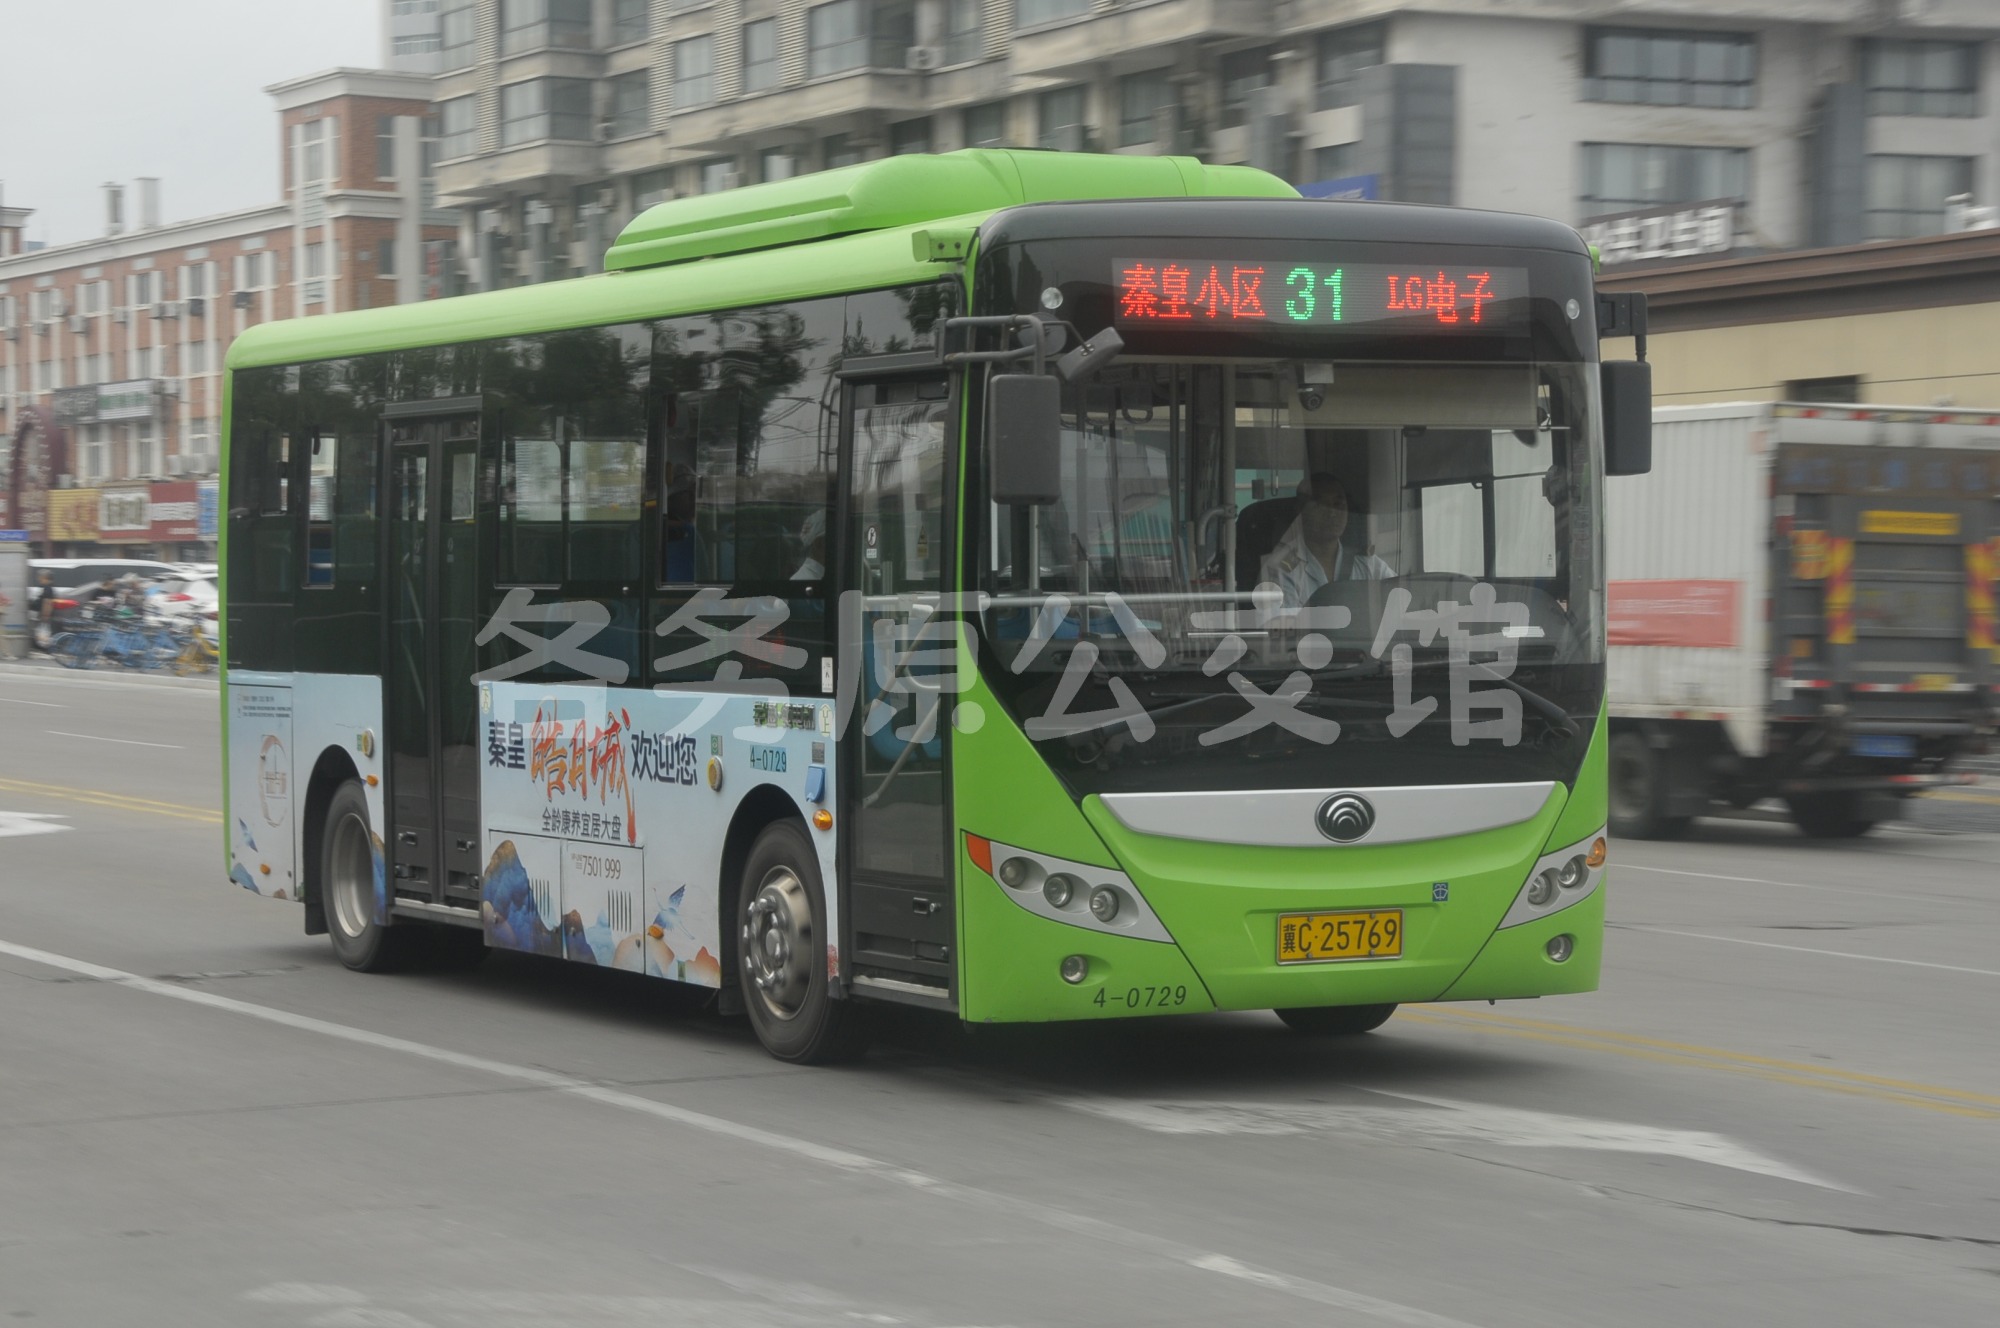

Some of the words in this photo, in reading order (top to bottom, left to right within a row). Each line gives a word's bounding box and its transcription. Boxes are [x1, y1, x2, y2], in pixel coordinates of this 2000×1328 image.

[1120, 264, 1266, 319] 秦皇小区
[1285, 267, 1343, 321] 31
[1387, 271, 1494, 323] LG电子
[488, 720, 526, 770] 秦皇
[530, 697, 637, 847] 皓月城
[631, 730, 698, 786] 欢迎您
[750, 745, 787, 773] 4-0729
[541, 806, 622, 842] 全龄康养宜居大盘
[582, 854, 602, 878] 7501
[604, 857, 622, 880] 999
[1092, 985, 1187, 1009] 4-0729
